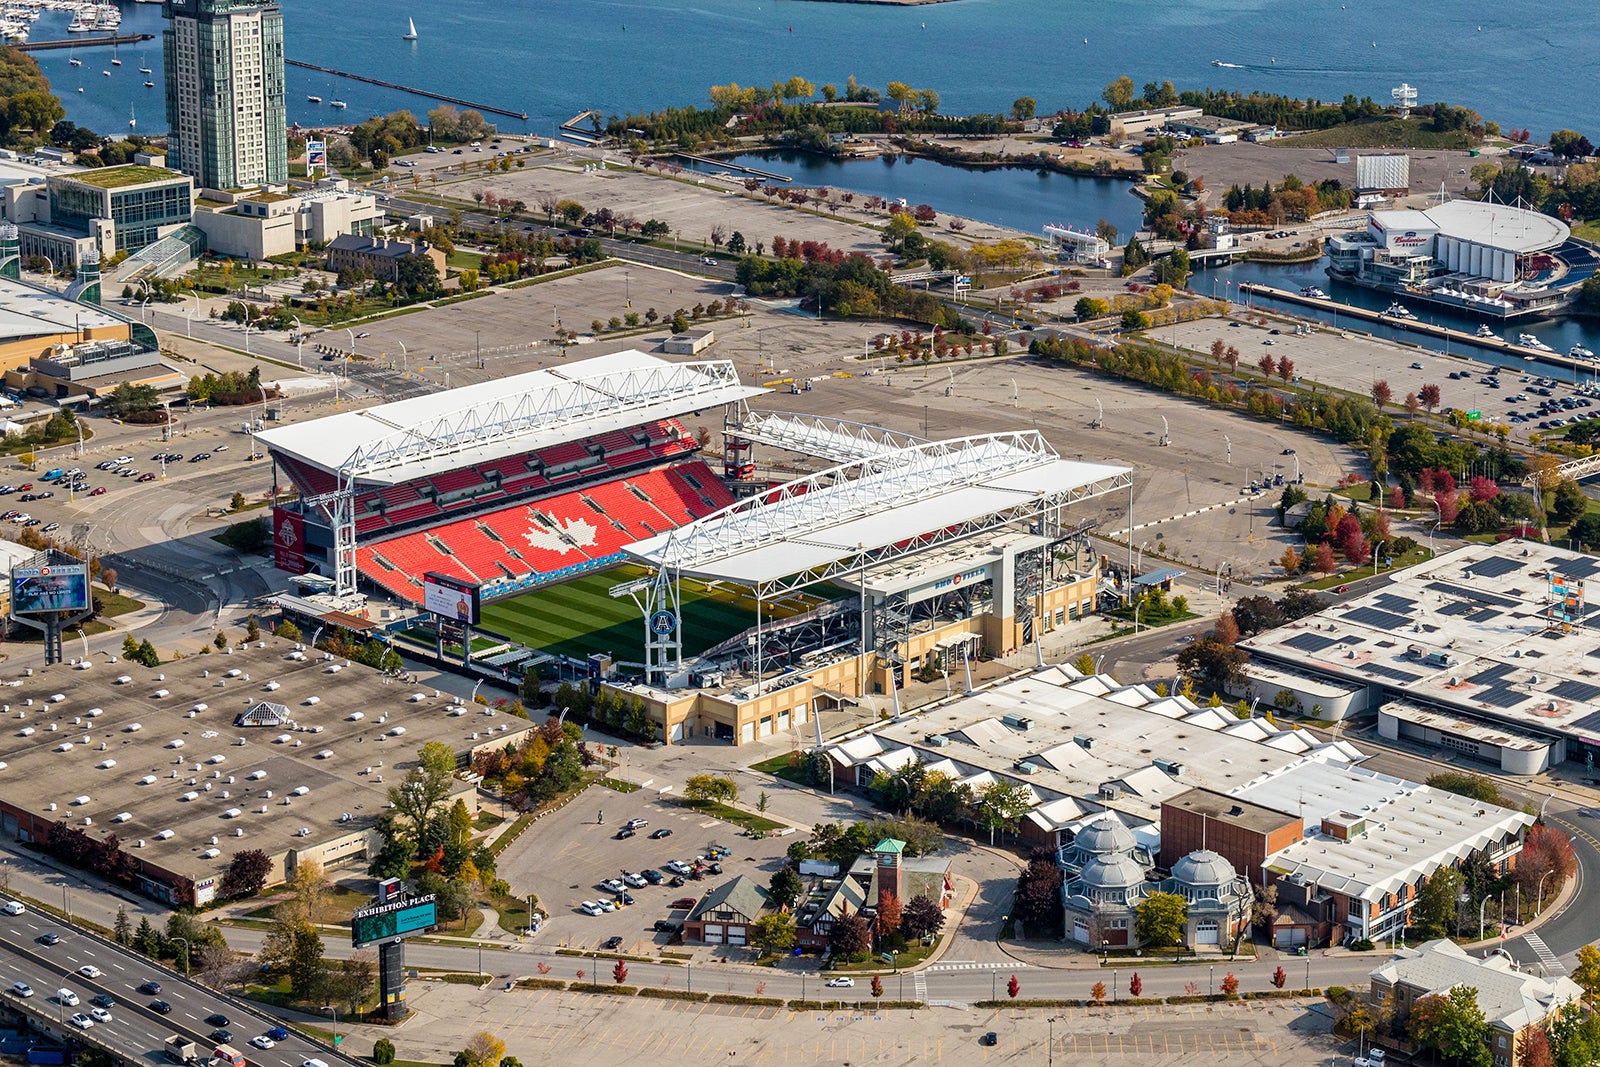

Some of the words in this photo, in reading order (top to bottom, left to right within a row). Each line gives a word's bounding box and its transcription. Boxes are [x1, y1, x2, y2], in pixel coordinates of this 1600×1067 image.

[935, 579, 952, 589] BMO
[963, 568, 986, 580] FIELD
[358, 900, 408, 918] EXHIBITION
[410, 894, 436, 906] PLACE
